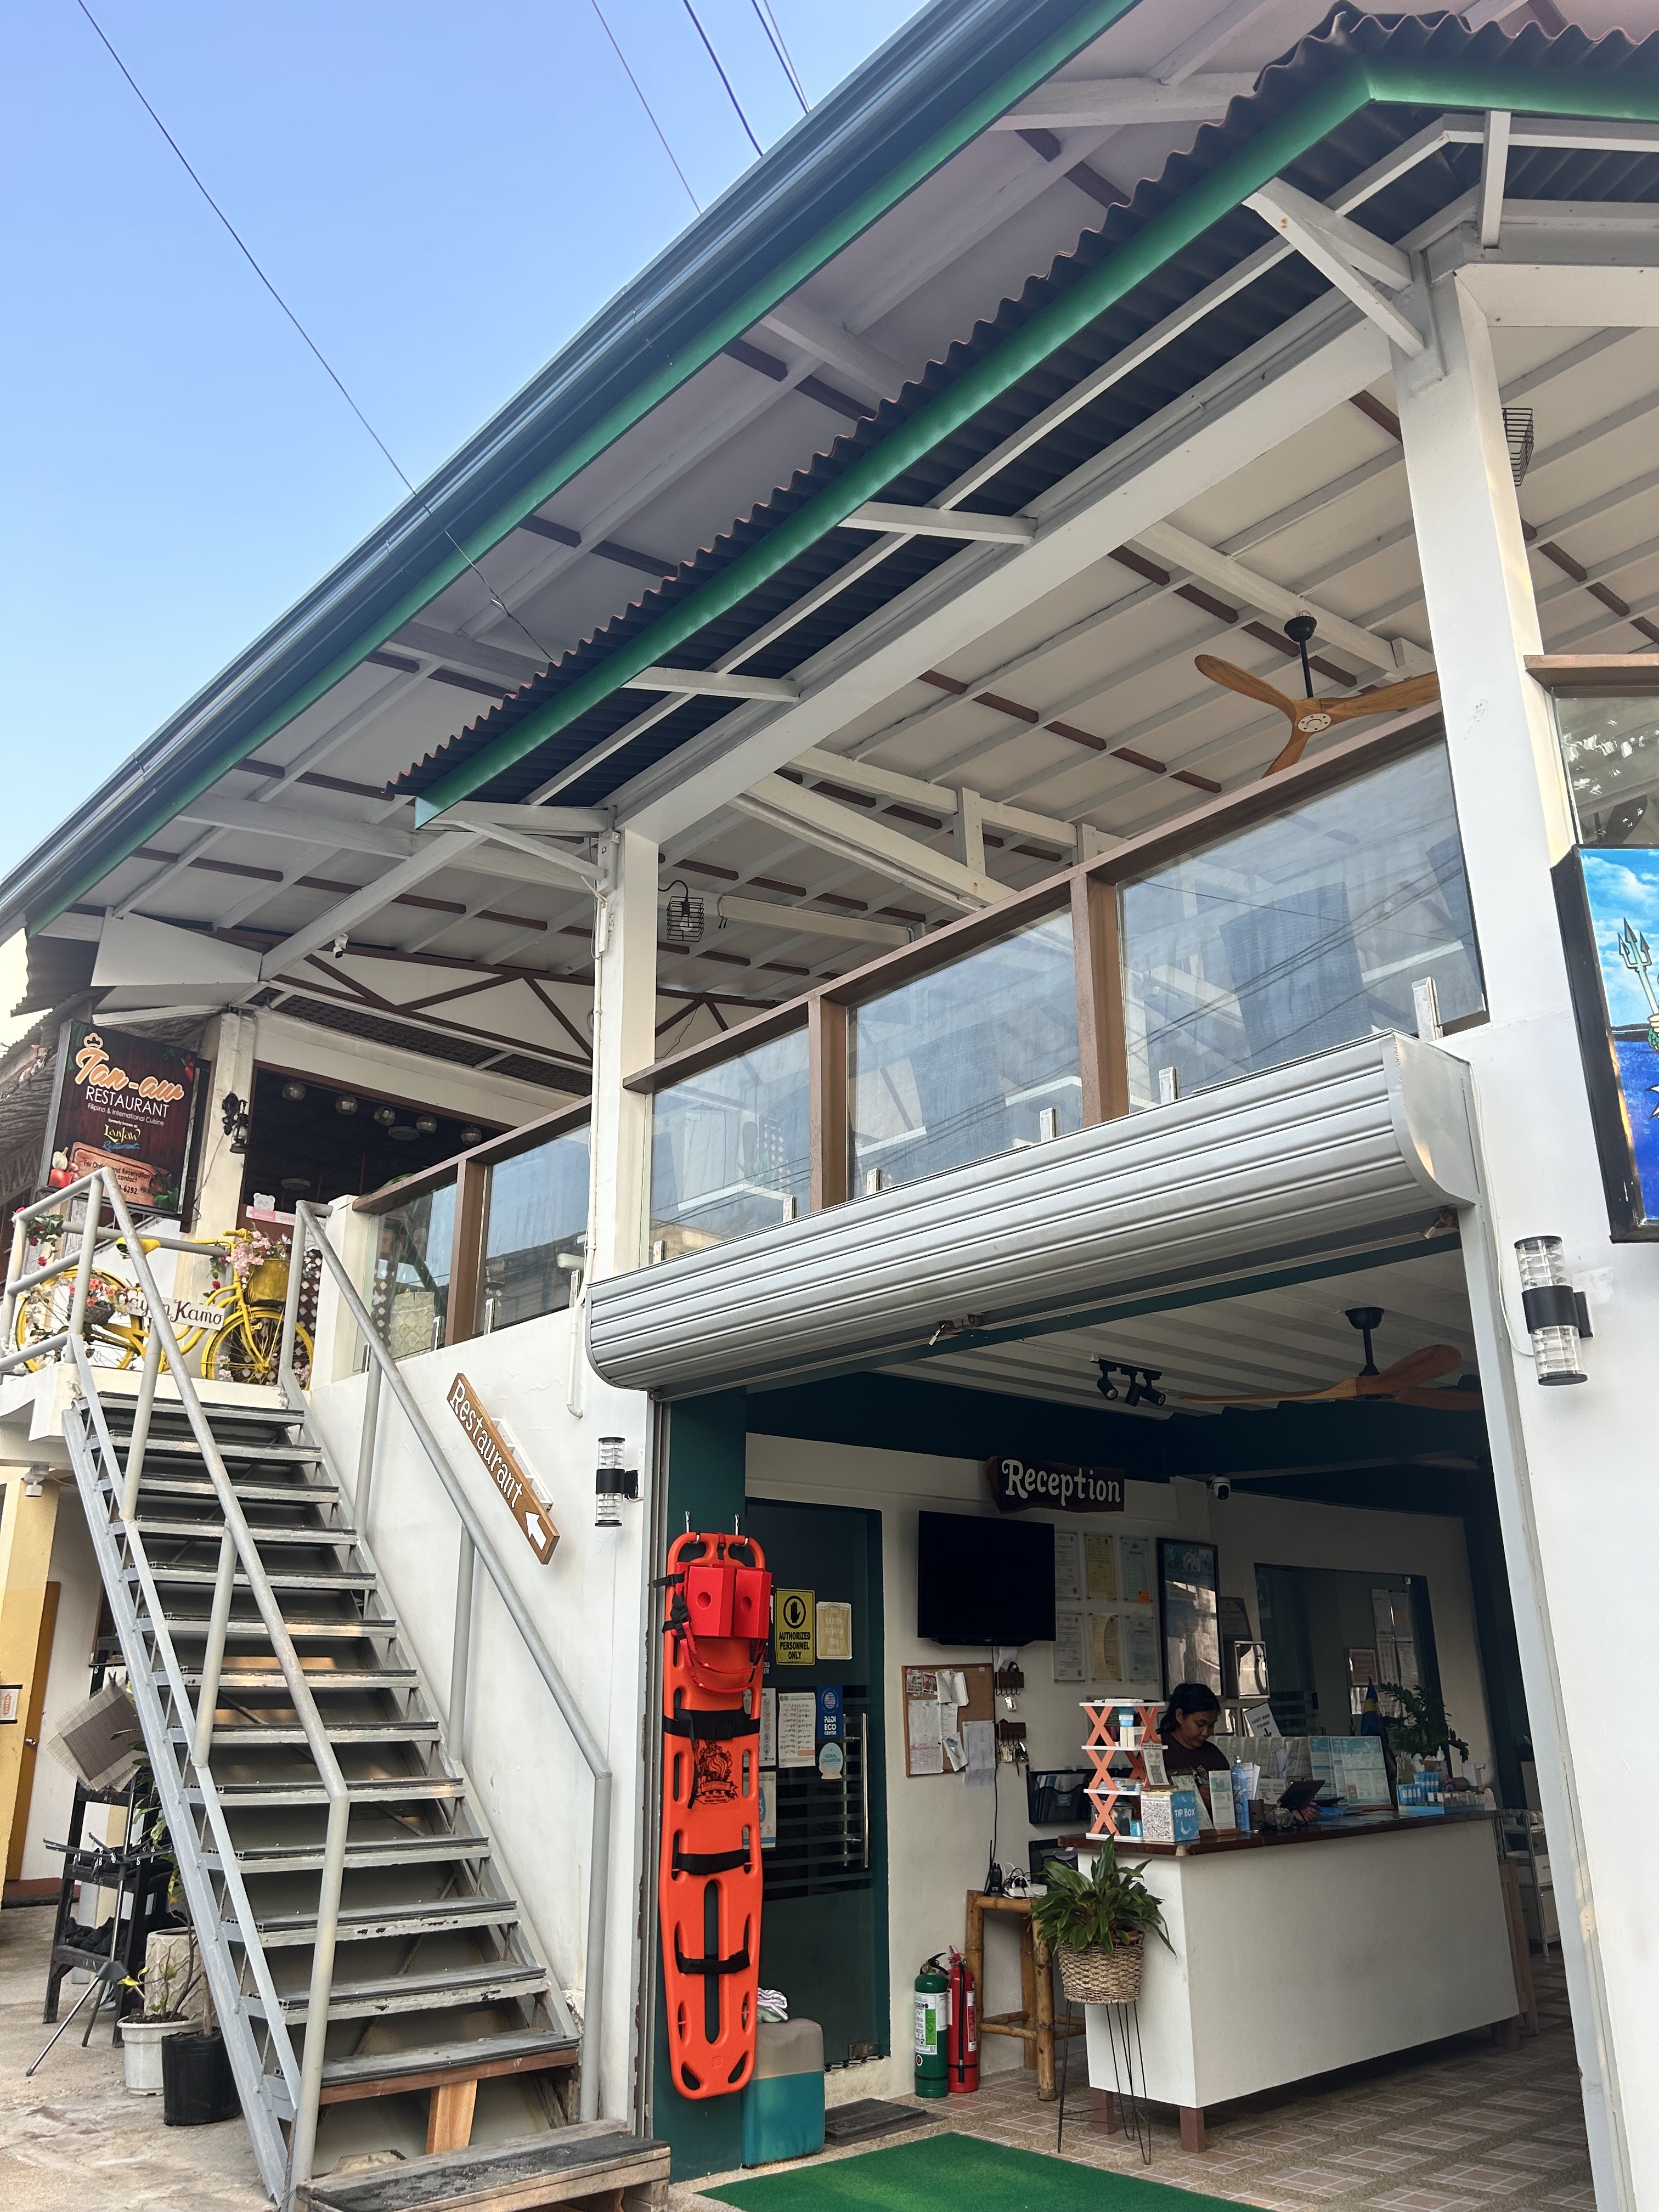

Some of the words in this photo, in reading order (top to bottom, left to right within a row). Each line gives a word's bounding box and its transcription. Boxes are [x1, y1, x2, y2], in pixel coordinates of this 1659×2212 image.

[86, 1085, 170, 1118] RESTAURANT
[87, 1102, 106, 1113] Filipino
[112, 1109, 145, 1122] International
[145, 1116, 165, 1126] Cuisine
[122, 1168, 150, 1179] Reservation
[117, 1175, 137, 1183] contact
[170, 1299, 223, 1325] Kamo
[448, 1379, 524, 1509] Restaurant
[1001, 1458, 1121, 1506] Reception
[778, 1632, 811, 1640] AUTHORIZED
[780, 1641, 810, 1650] PERSONNEL
[788, 1651, 802, 1660] ONLY
[1256, 1720, 1271, 1729] FOUND
[1174, 1808, 1183, 1818] TIP
[1184, 1808, 1195, 1817] BOX
